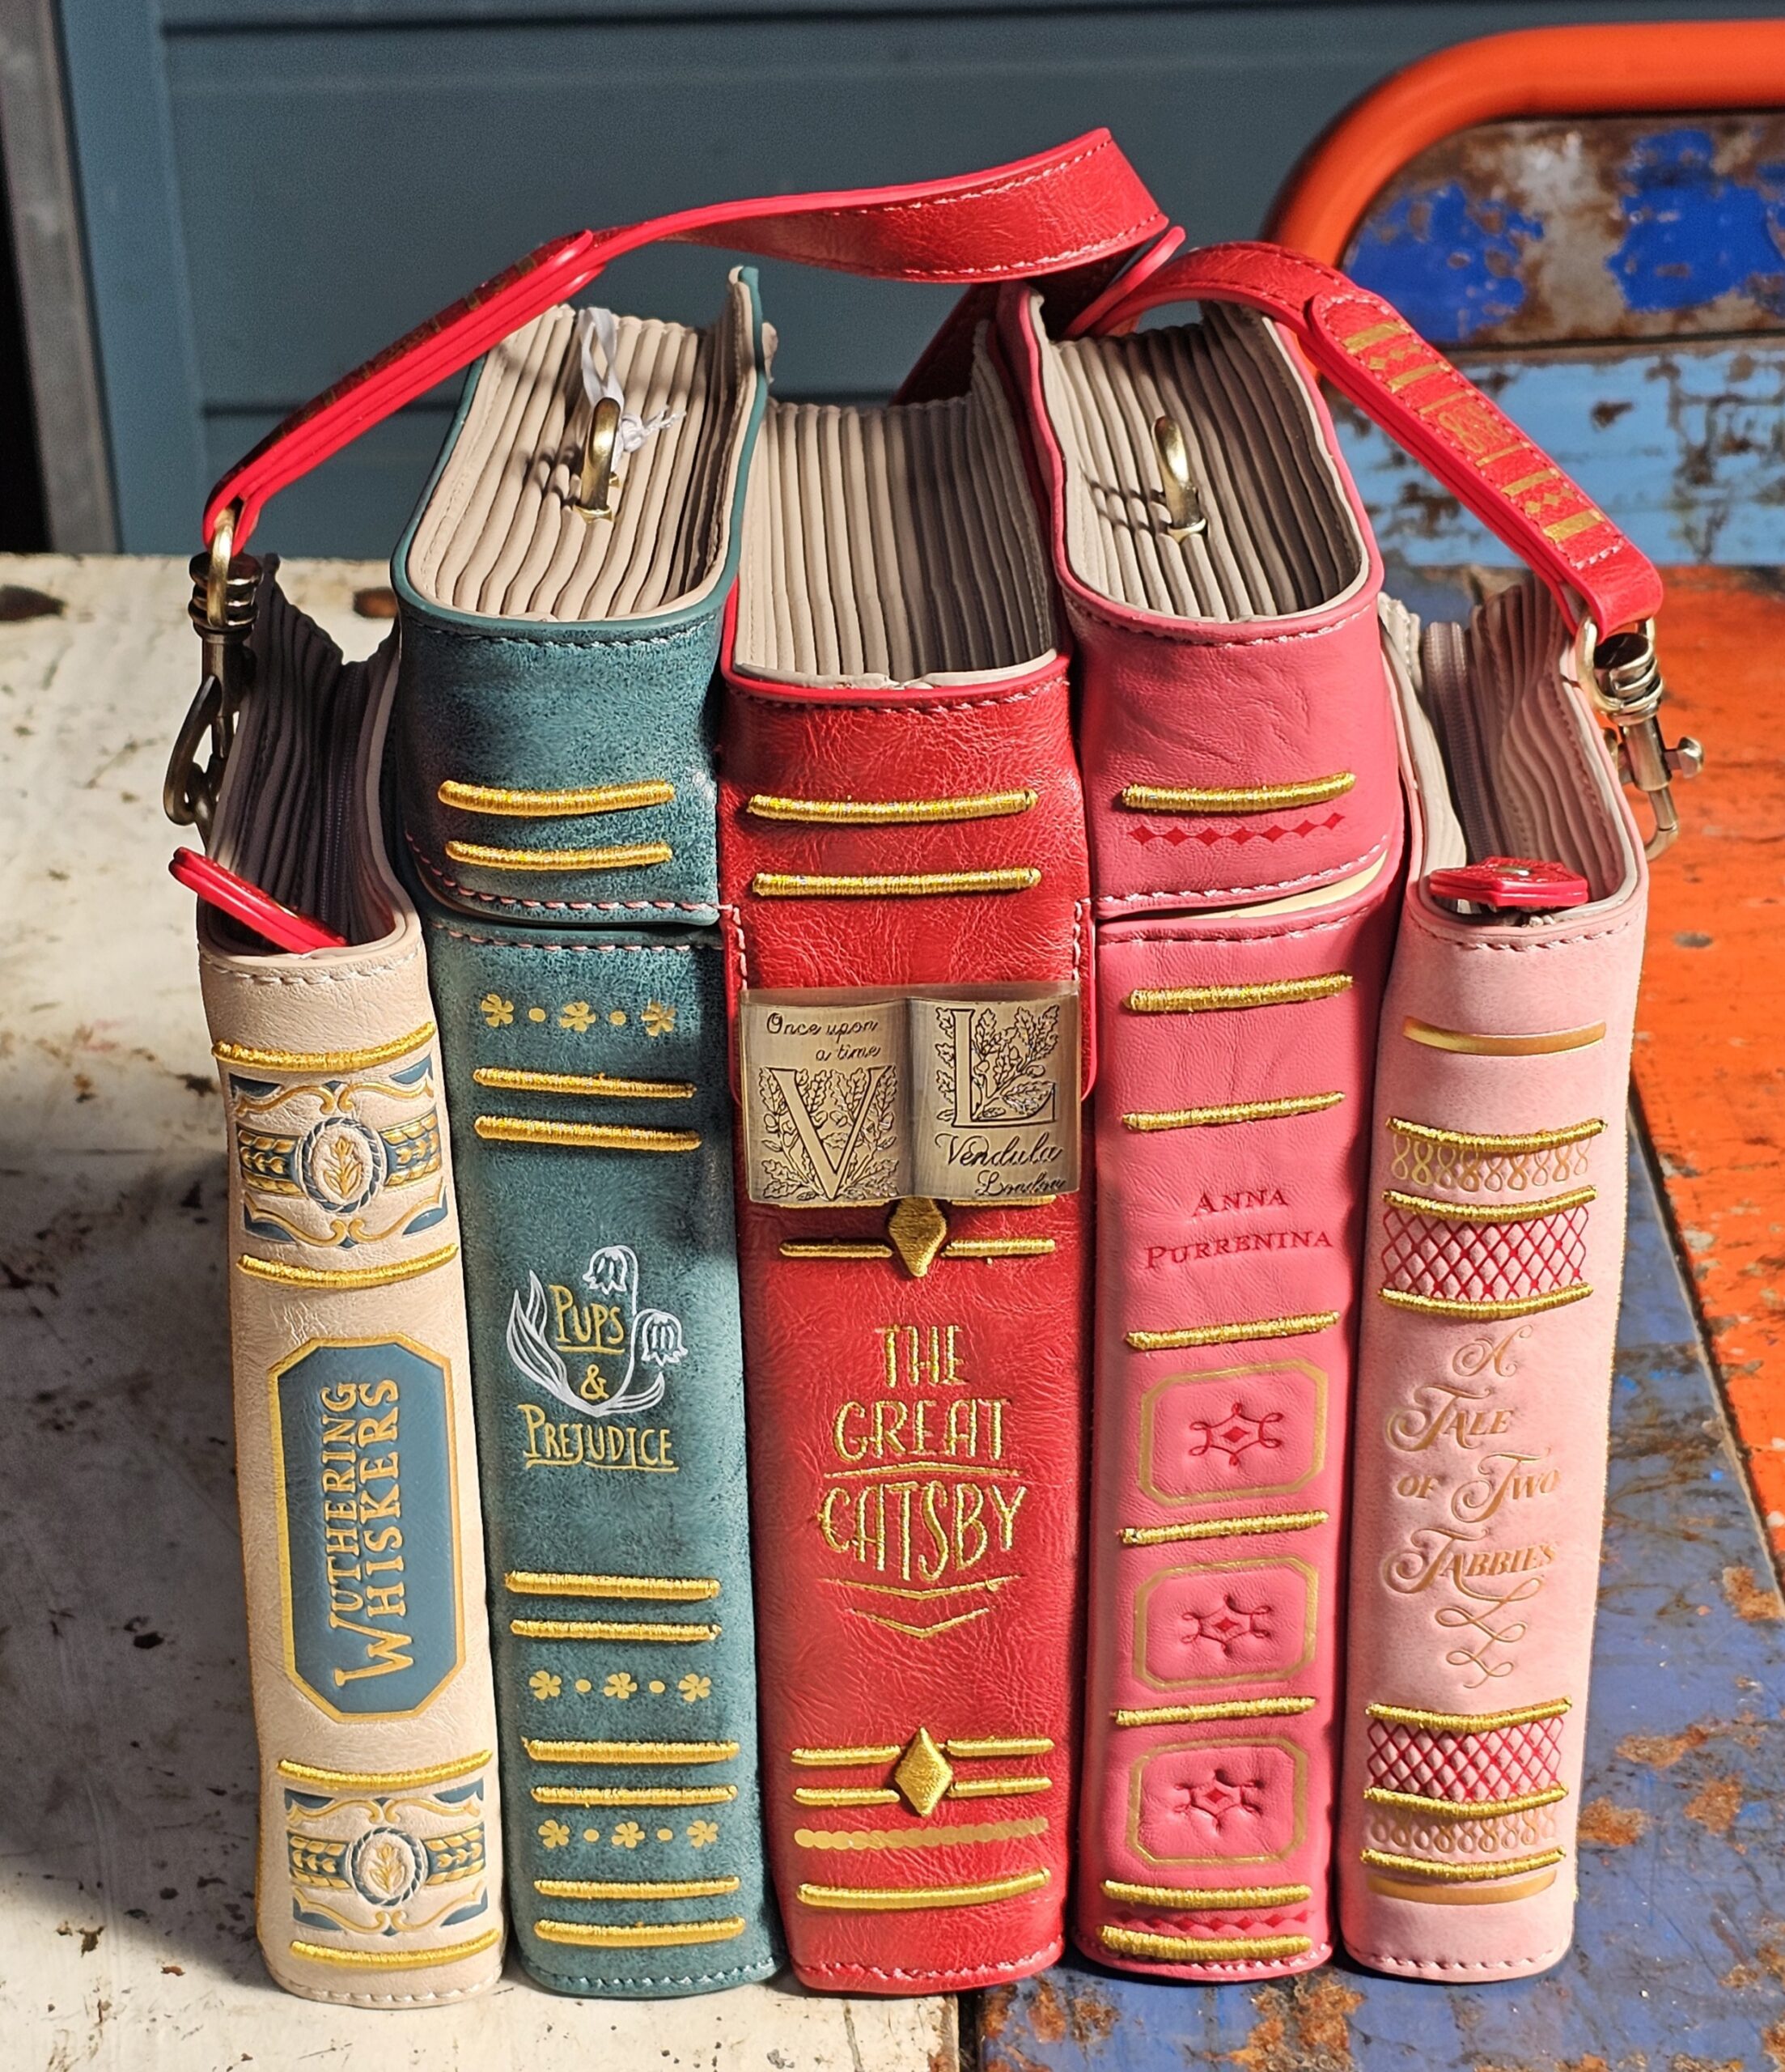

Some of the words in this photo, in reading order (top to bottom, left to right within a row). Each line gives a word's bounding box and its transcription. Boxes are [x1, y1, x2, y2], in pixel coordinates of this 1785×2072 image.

[766, 1012, 822, 1036] Once
[825, 1020, 879, 1044] upon
[815, 1048, 832, 1062] a
[837, 1043, 881, 1060] time
[934, 1131, 1064, 1166] Vendula
[974, 1170, 1066, 1196] London
[1191, 1189, 1289, 1217] ANNA
[1144, 1231, 1333, 1270] PURRENINA
[549, 1284, 625, 1349] PUPS
[875, 1324, 970, 1389] THE
[1452, 1324, 1534, 1377] A
[579, 1364, 609, 1399] &
[518, 1403, 676, 1468] PREJUDICE
[833, 1398, 1012, 1463] GREAT
[1385, 1384, 1515, 1451] TALE
[1384, 1526, 1558, 1594] TABBIES
